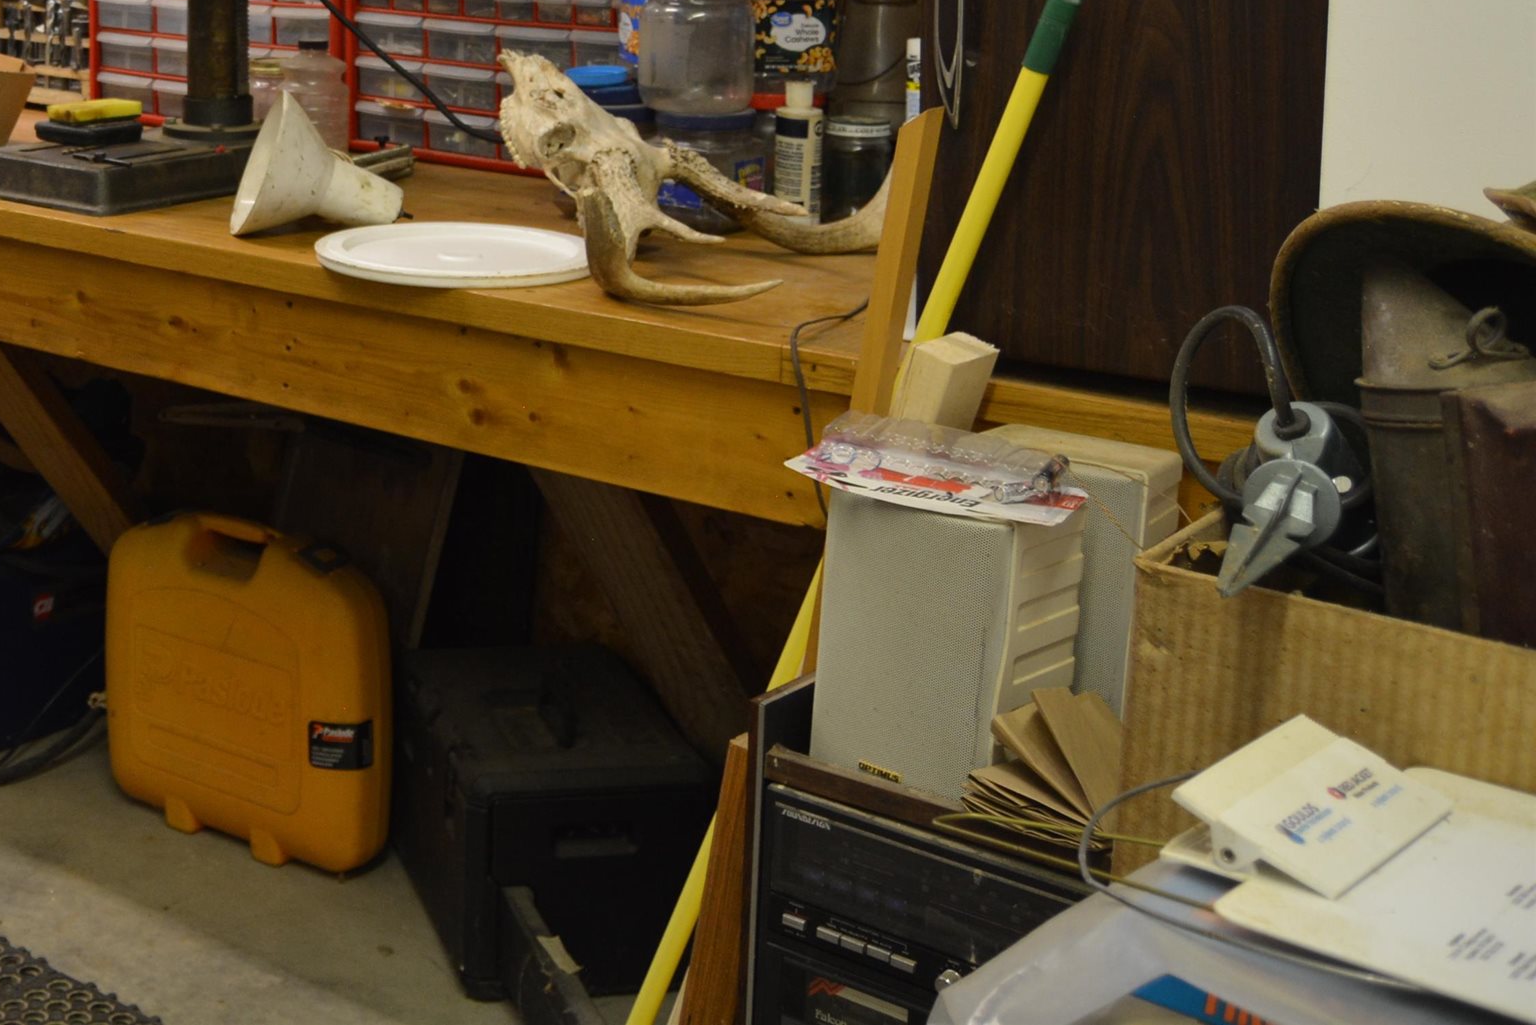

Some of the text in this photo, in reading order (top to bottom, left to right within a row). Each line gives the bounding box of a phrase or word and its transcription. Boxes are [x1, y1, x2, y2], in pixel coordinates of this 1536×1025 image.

[784, 35, 820, 44] Cashews
[794, 28, 820, 36] Whole
[870, 485, 983, 509] Energizer
[858, 761, 900, 784] OPTIMUS
[1281, 802, 1321, 829] GOULDS
